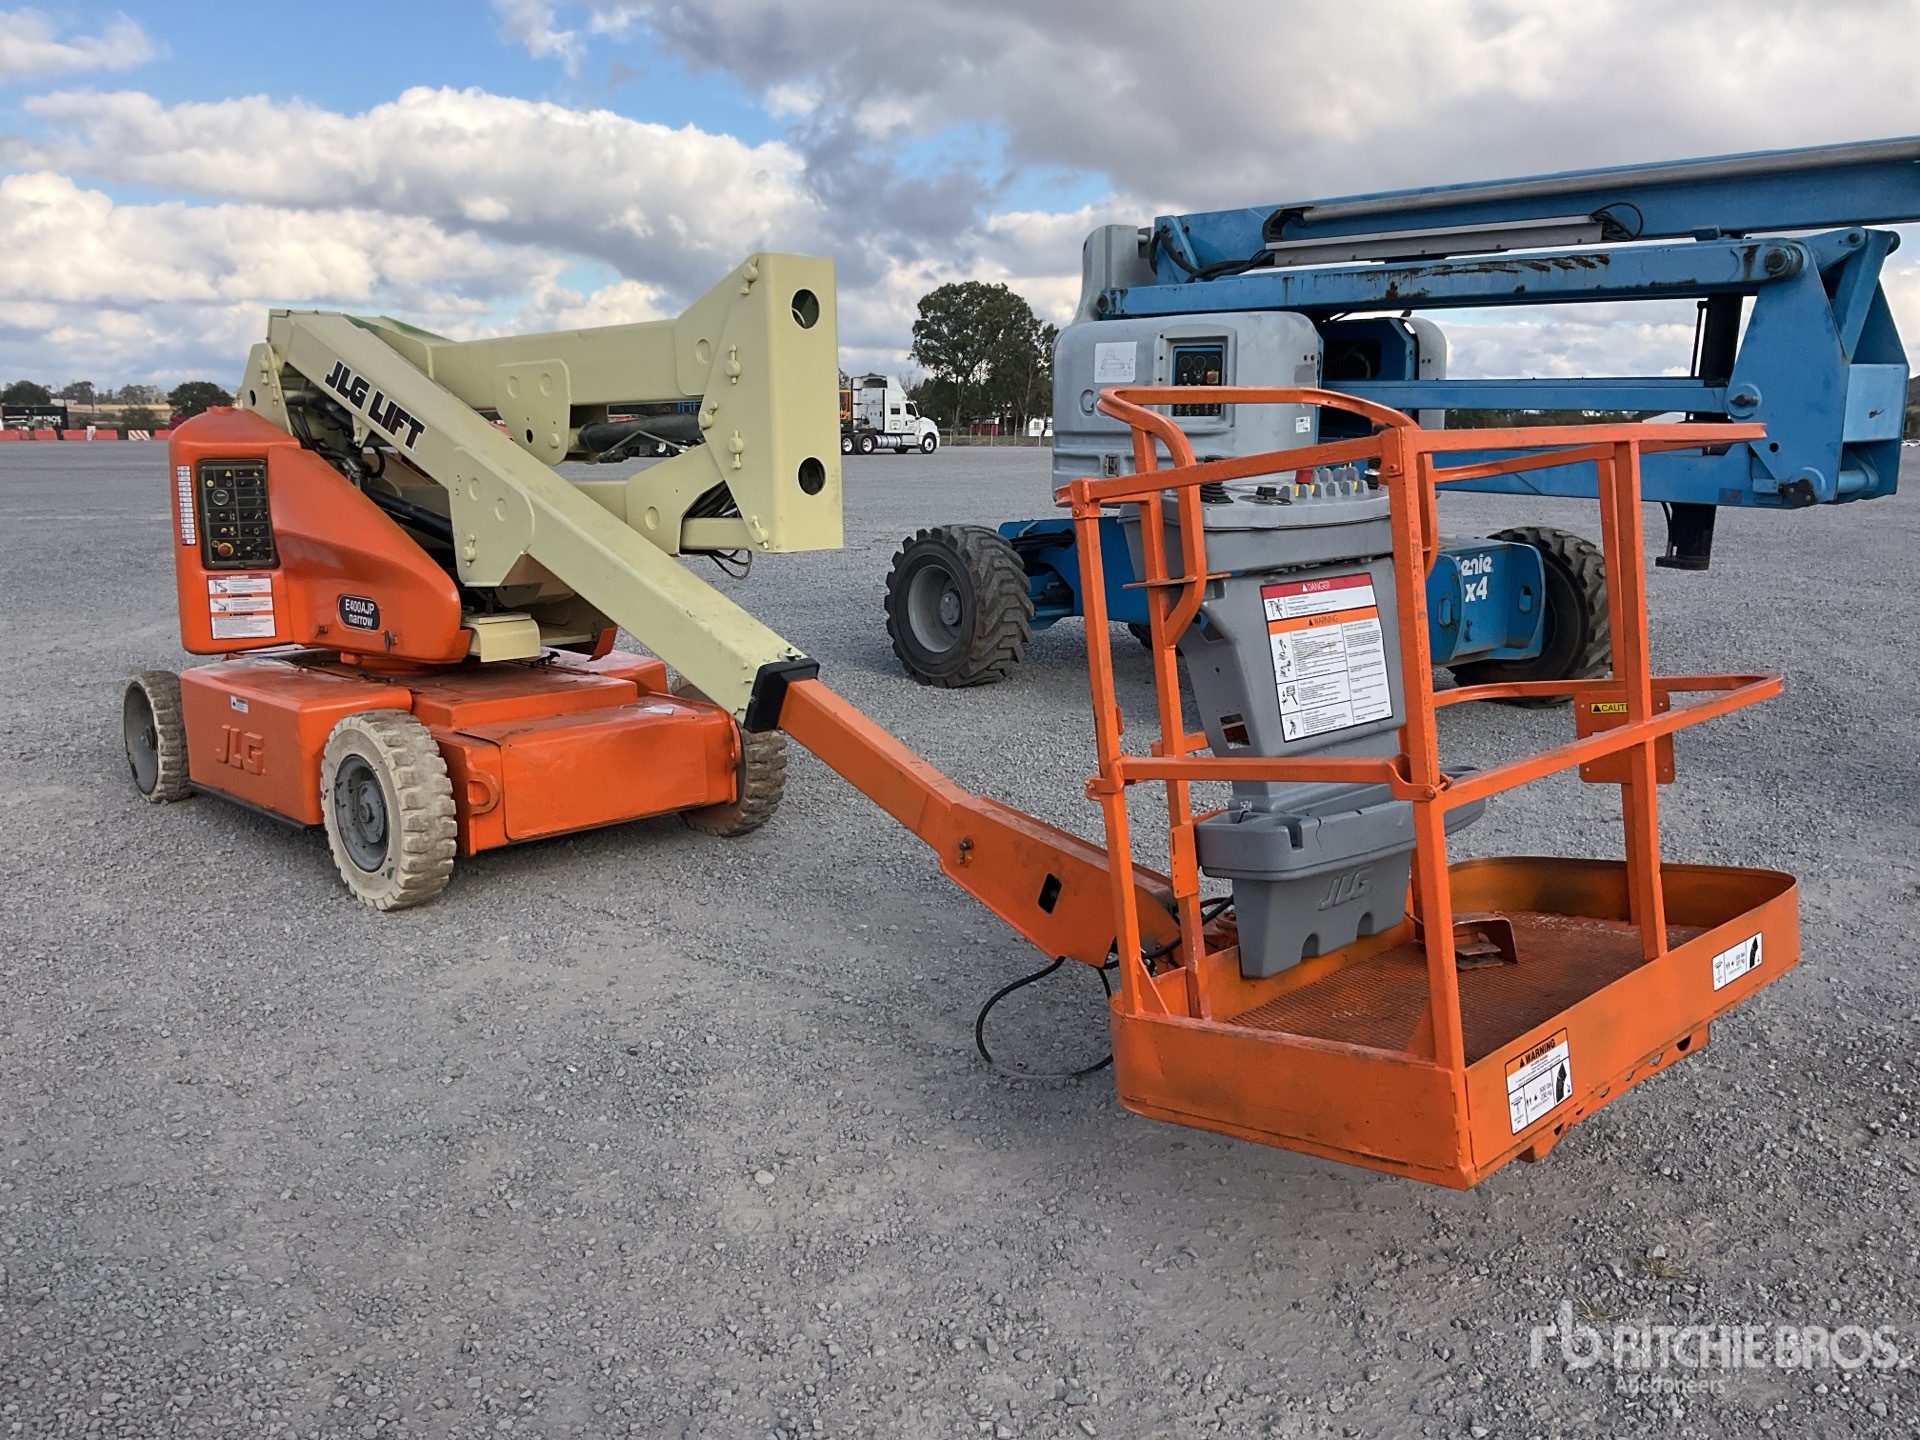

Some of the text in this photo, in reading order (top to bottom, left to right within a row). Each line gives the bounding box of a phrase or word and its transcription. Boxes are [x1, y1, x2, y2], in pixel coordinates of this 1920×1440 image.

[324, 359, 426, 449] JLG LIFT
[1456, 553, 1492, 576] enie
[1307, 581, 1331, 592] DANGER
[1465, 576, 1488, 602] x4
[344, 598, 375, 616] E400AJP
[348, 612, 374, 628] narrow
[1314, 614, 1339, 626] WARNING
[1601, 704, 1628, 712] CAUTI
[214, 724, 266, 777] JLG
[1317, 864, 1373, 912] JLG
[1525, 1038, 1556, 1065] WARNING
